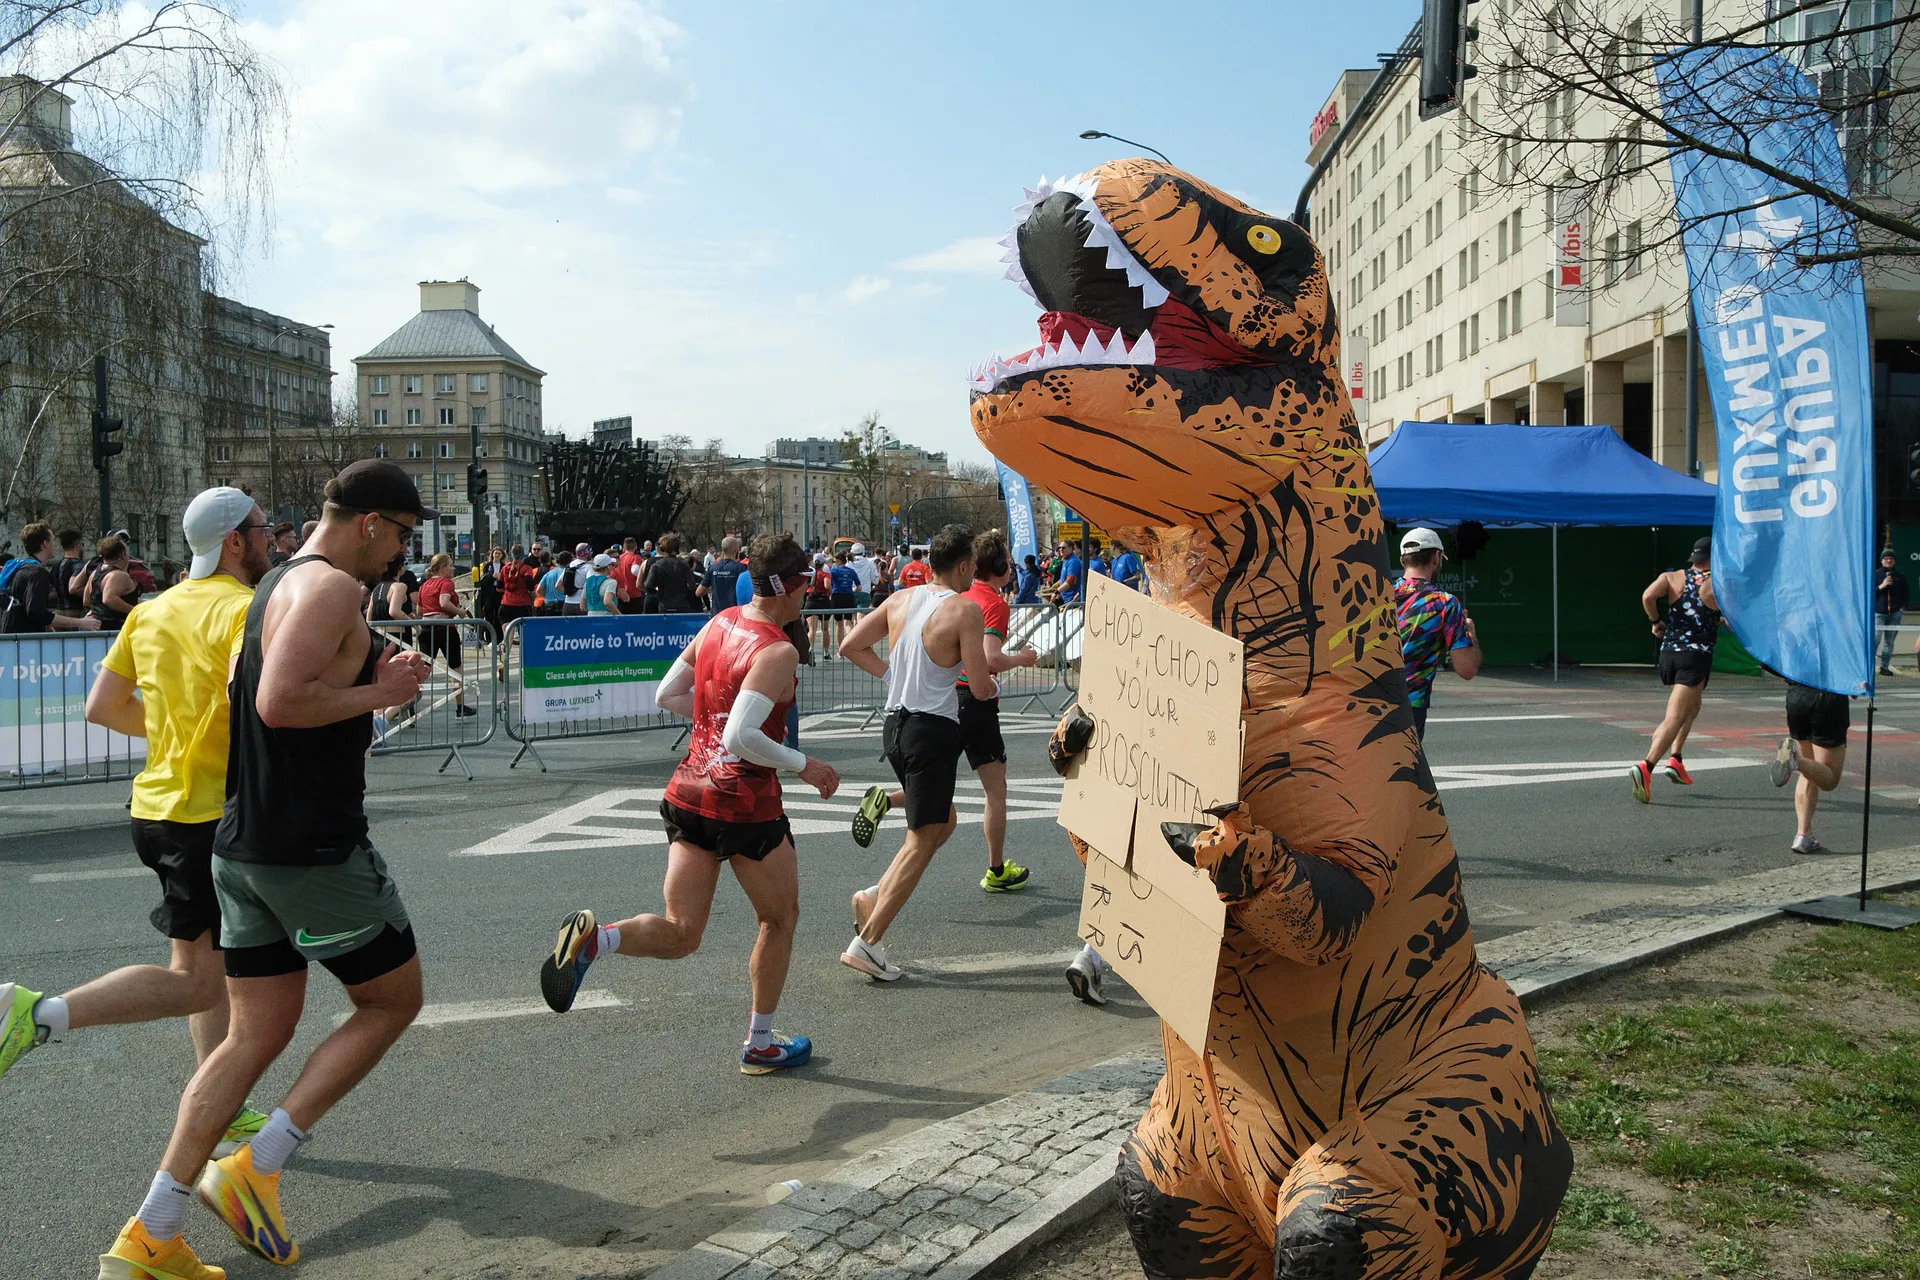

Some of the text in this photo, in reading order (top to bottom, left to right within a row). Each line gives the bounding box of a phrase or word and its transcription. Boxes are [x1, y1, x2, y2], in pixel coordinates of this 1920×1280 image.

[1562, 223, 1581, 256] ibis
[1351, 361, 1363, 382] ibis
[545, 633, 605, 652] Zdrowie
[608, 634, 622, 648] to
[625, 631, 664, 650] Twoja
[545, 667, 653, 681] Ciesz się aktywnością fizyczną
[545, 696, 595, 707] GRUPA LUXMED
[1116, 660, 1179, 727] YOUR
